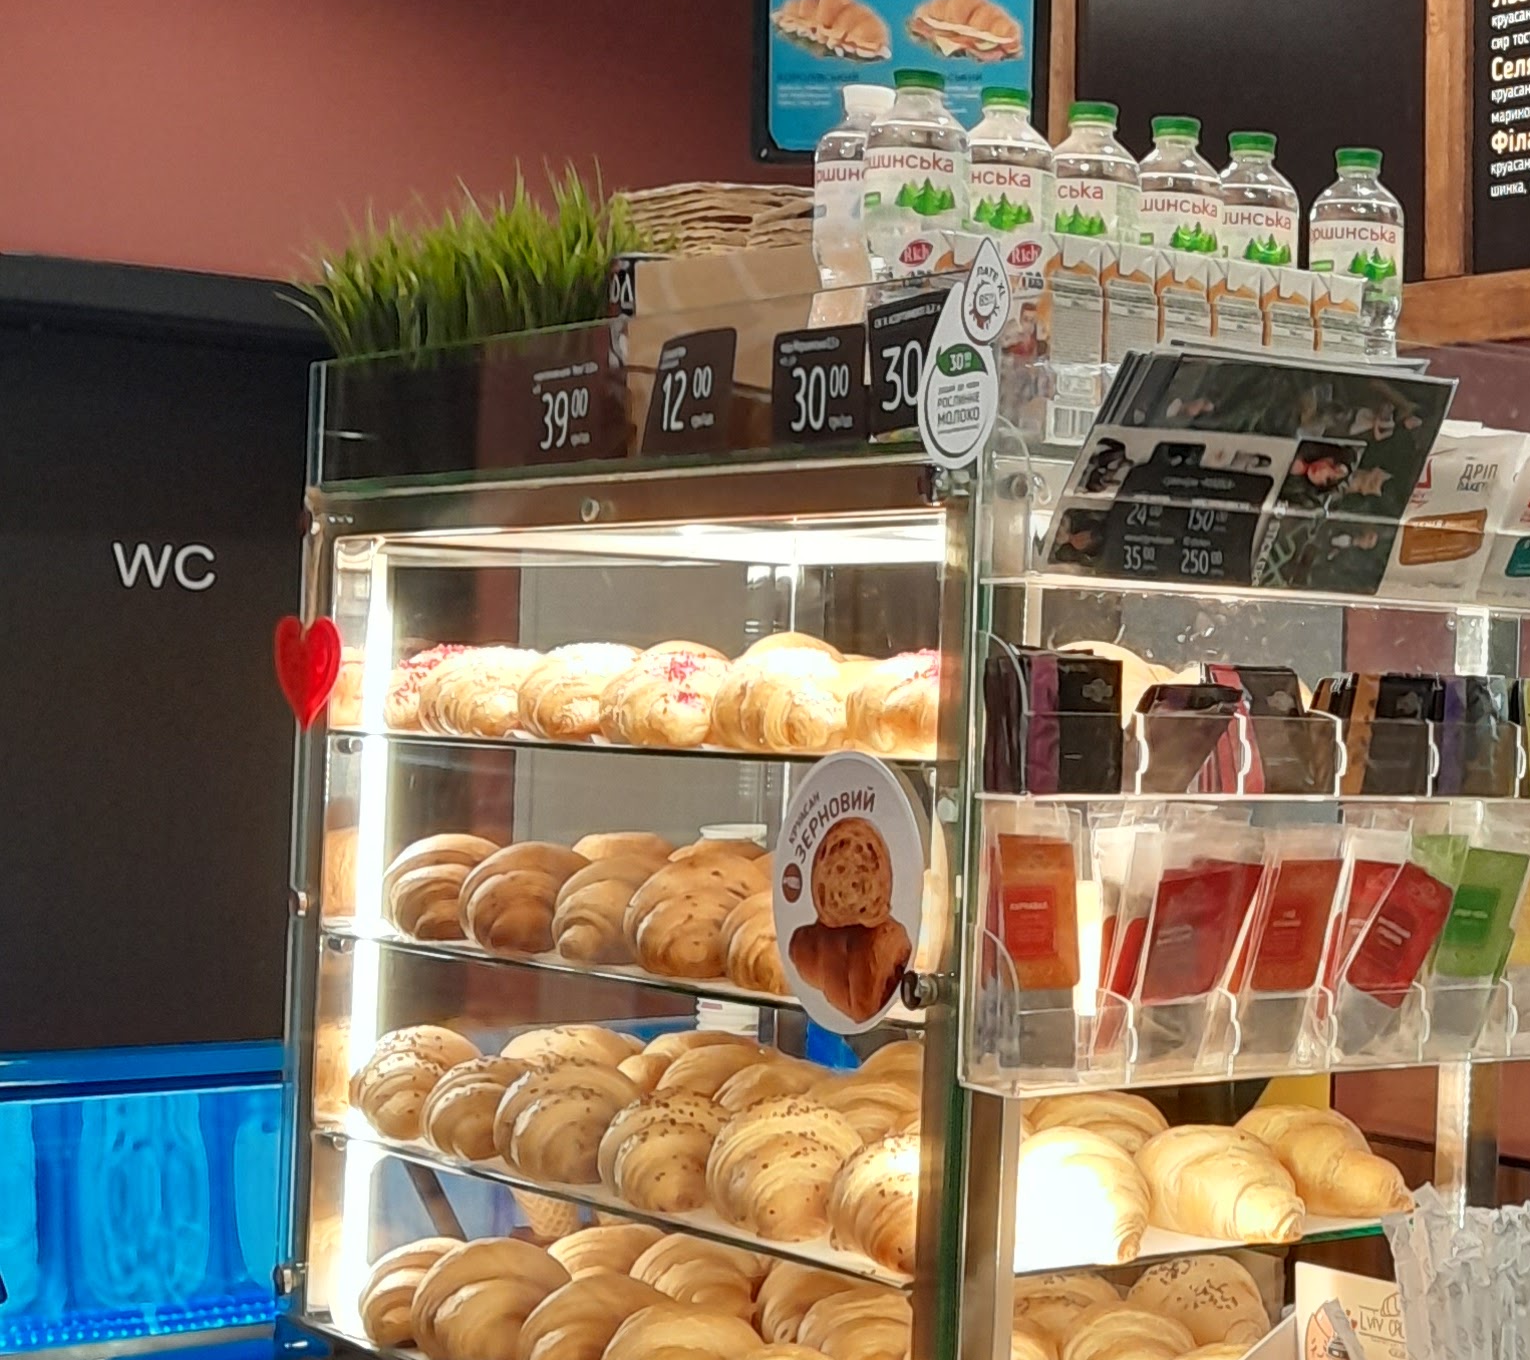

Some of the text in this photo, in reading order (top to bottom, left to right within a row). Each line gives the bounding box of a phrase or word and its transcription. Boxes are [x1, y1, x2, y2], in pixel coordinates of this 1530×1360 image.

[662, 365, 712, 431] 12 00
[790, 364, 849, 432] 30 00
[881, 340, 922, 412] 30
[540, 387, 589, 450] 39 00
[937, 407, 980, 425] МОЛОКО
[1462, 464, 1498, 481] ДРІП
[113, 542, 216, 590] WC
[794, 786, 876, 865] ЗЕРНОВИЙ
